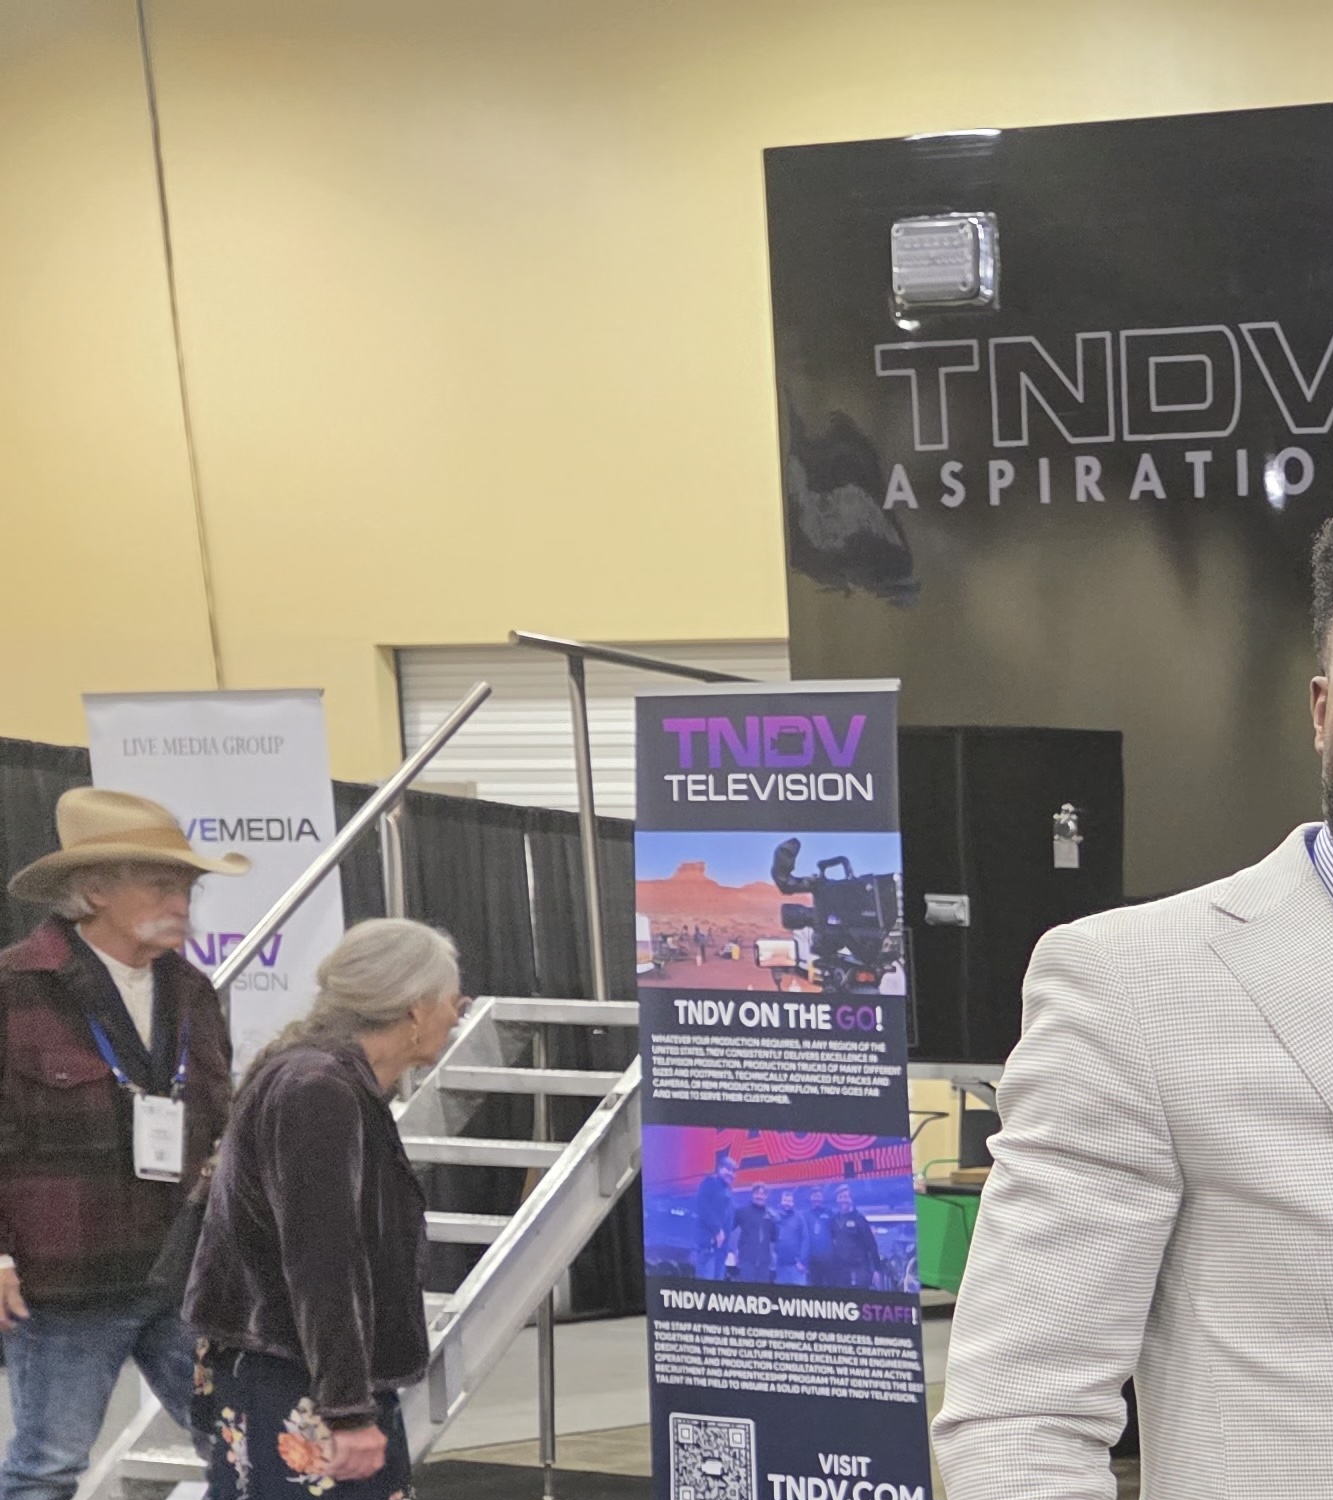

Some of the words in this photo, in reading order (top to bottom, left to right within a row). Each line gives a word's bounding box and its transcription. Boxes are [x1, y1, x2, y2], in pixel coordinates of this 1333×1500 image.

[123, 738, 158, 756] LIVE
[163, 737, 219, 756] MEDIA
[222, 736, 284, 755] GROUP
[662, 715, 867, 769] TNDV
[664, 773, 874, 802] TELEVISION
[184, 932, 283, 968] NDV
[674, 1000, 735, 1026] TNDV
[738, 1002, 780, 1028] ON
[783, 1004, 832, 1030] THE
[836, 1005, 884, 1032] GO!
[660, 1289, 706, 1312] TNDV
[707, 1293, 860, 1321] AWARD-WINNING
[862, 1305, 918, 1326] STAFF!
[818, 1453, 871, 1477] VISIT
